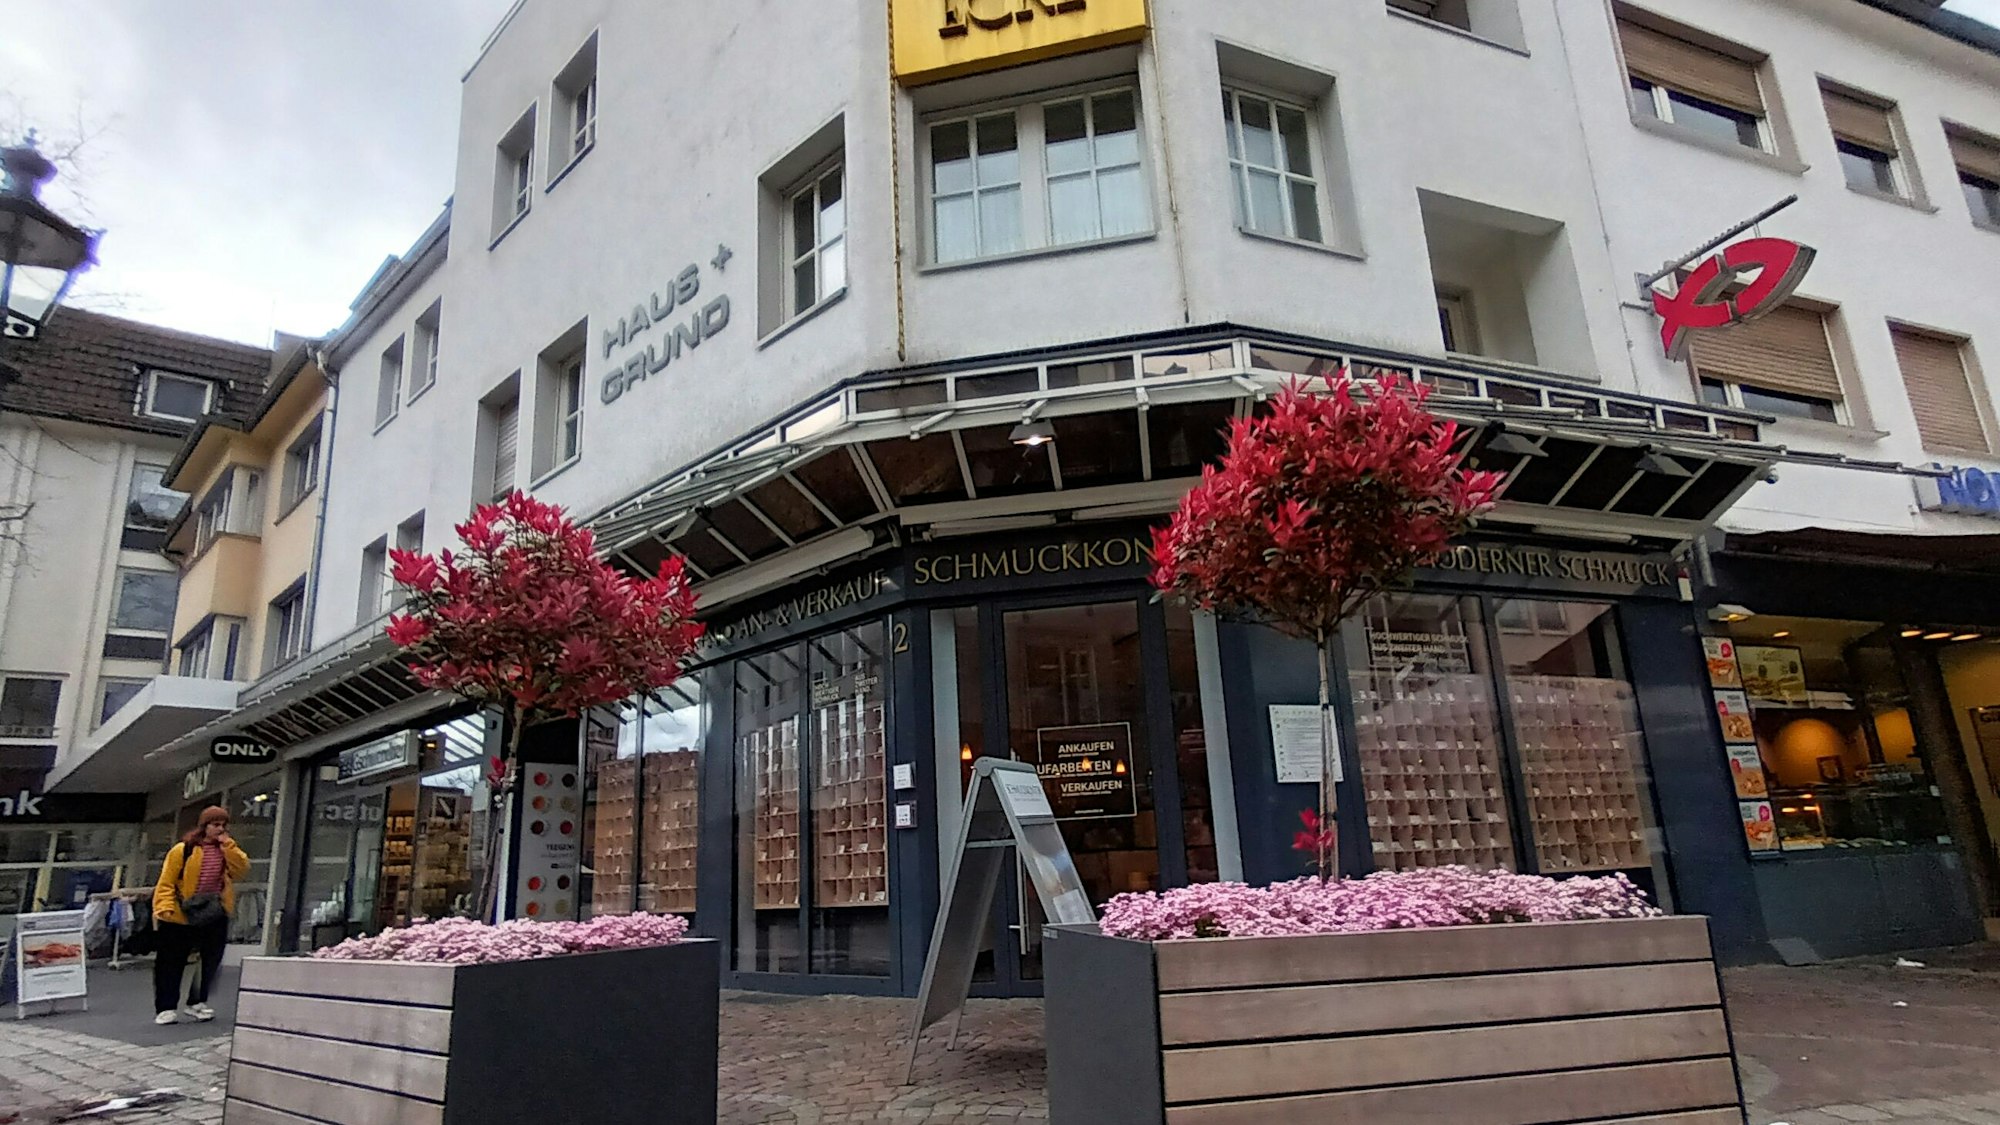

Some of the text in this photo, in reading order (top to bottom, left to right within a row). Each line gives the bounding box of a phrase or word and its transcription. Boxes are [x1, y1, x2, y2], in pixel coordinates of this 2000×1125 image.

[602, 262, 700, 361] HAUS
[600, 293, 730, 406] GRUND
[1558, 554, 1671, 585] SCHMUCK
[776, 603, 791, 626] &
[793, 568, 888, 620] VERKAUF
[893, 622, 909, 653] 2
[214, 742, 270, 756] ONLY
[1058, 740, 1115, 754] ANKAUFEN
[183, 762, 212, 799] ONLY
[1036, 759, 1111, 775] UFARBETEN
[1061, 779, 1123, 793] VERKAUFEN
